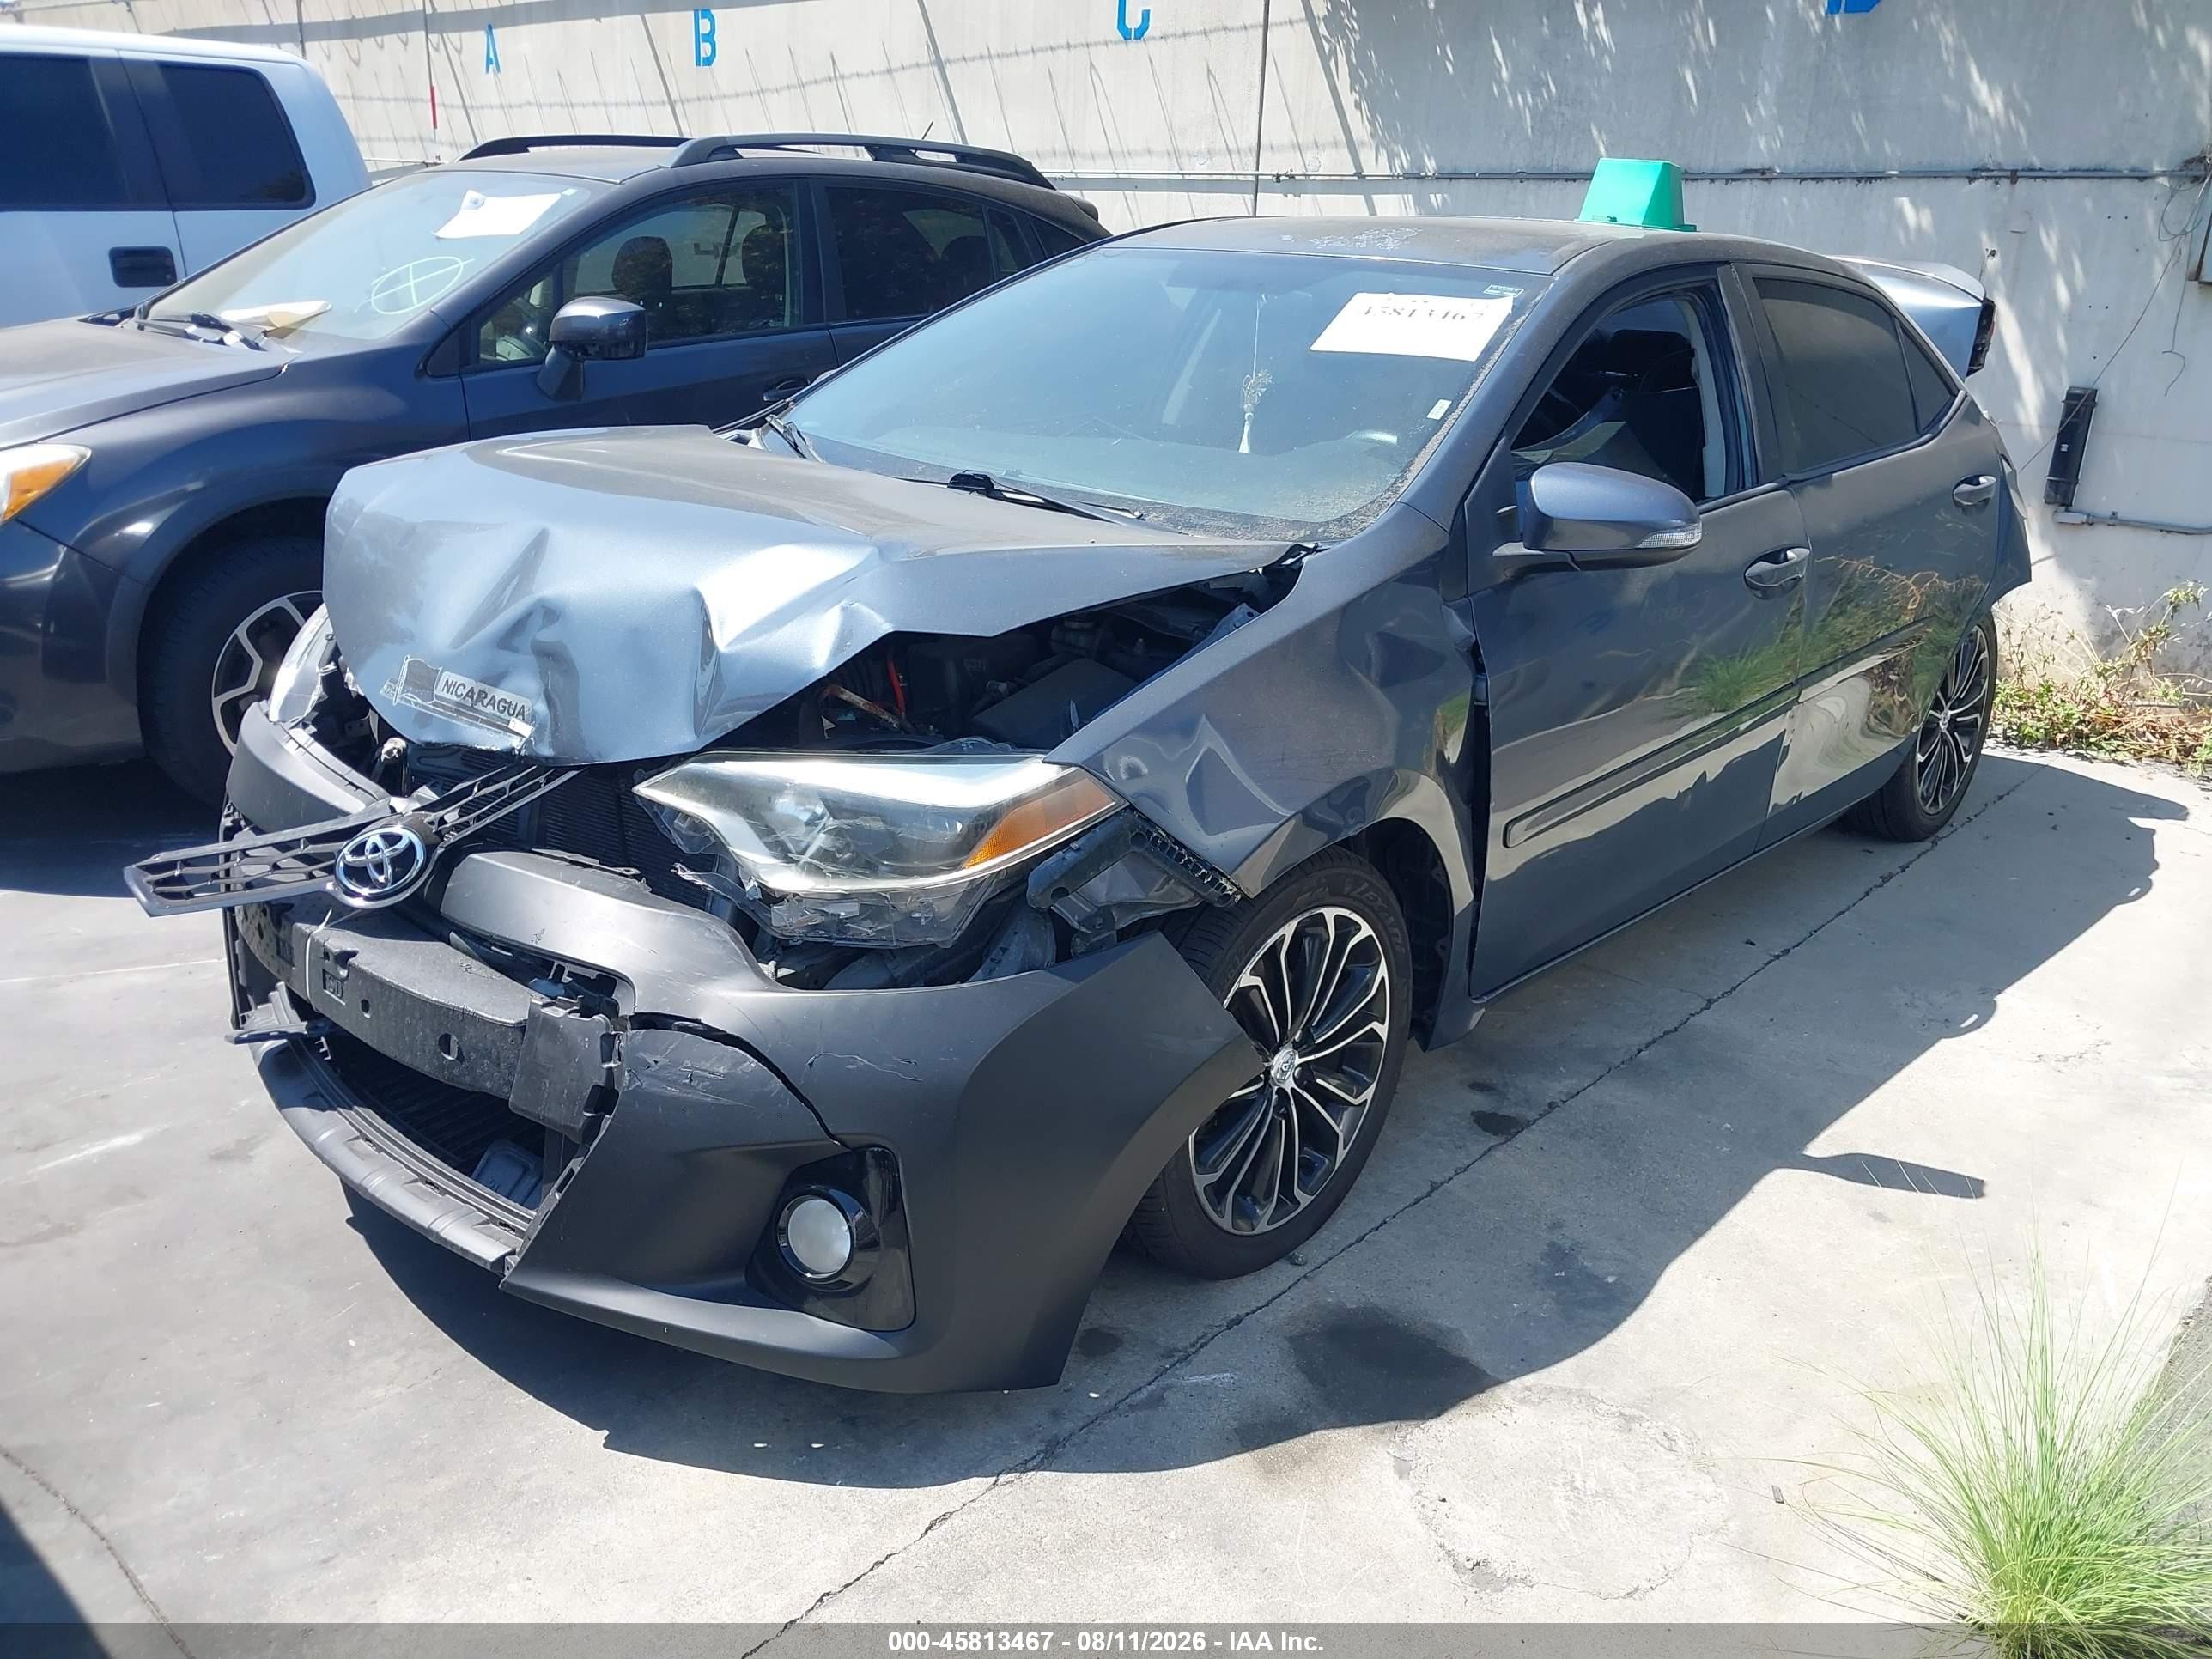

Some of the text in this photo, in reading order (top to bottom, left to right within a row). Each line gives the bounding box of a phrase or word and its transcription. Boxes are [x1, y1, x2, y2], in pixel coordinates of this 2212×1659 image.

[485, 24, 501, 73] A
[693, 9, 717, 66] B
[441, 678, 526, 721] NICARAGUA
